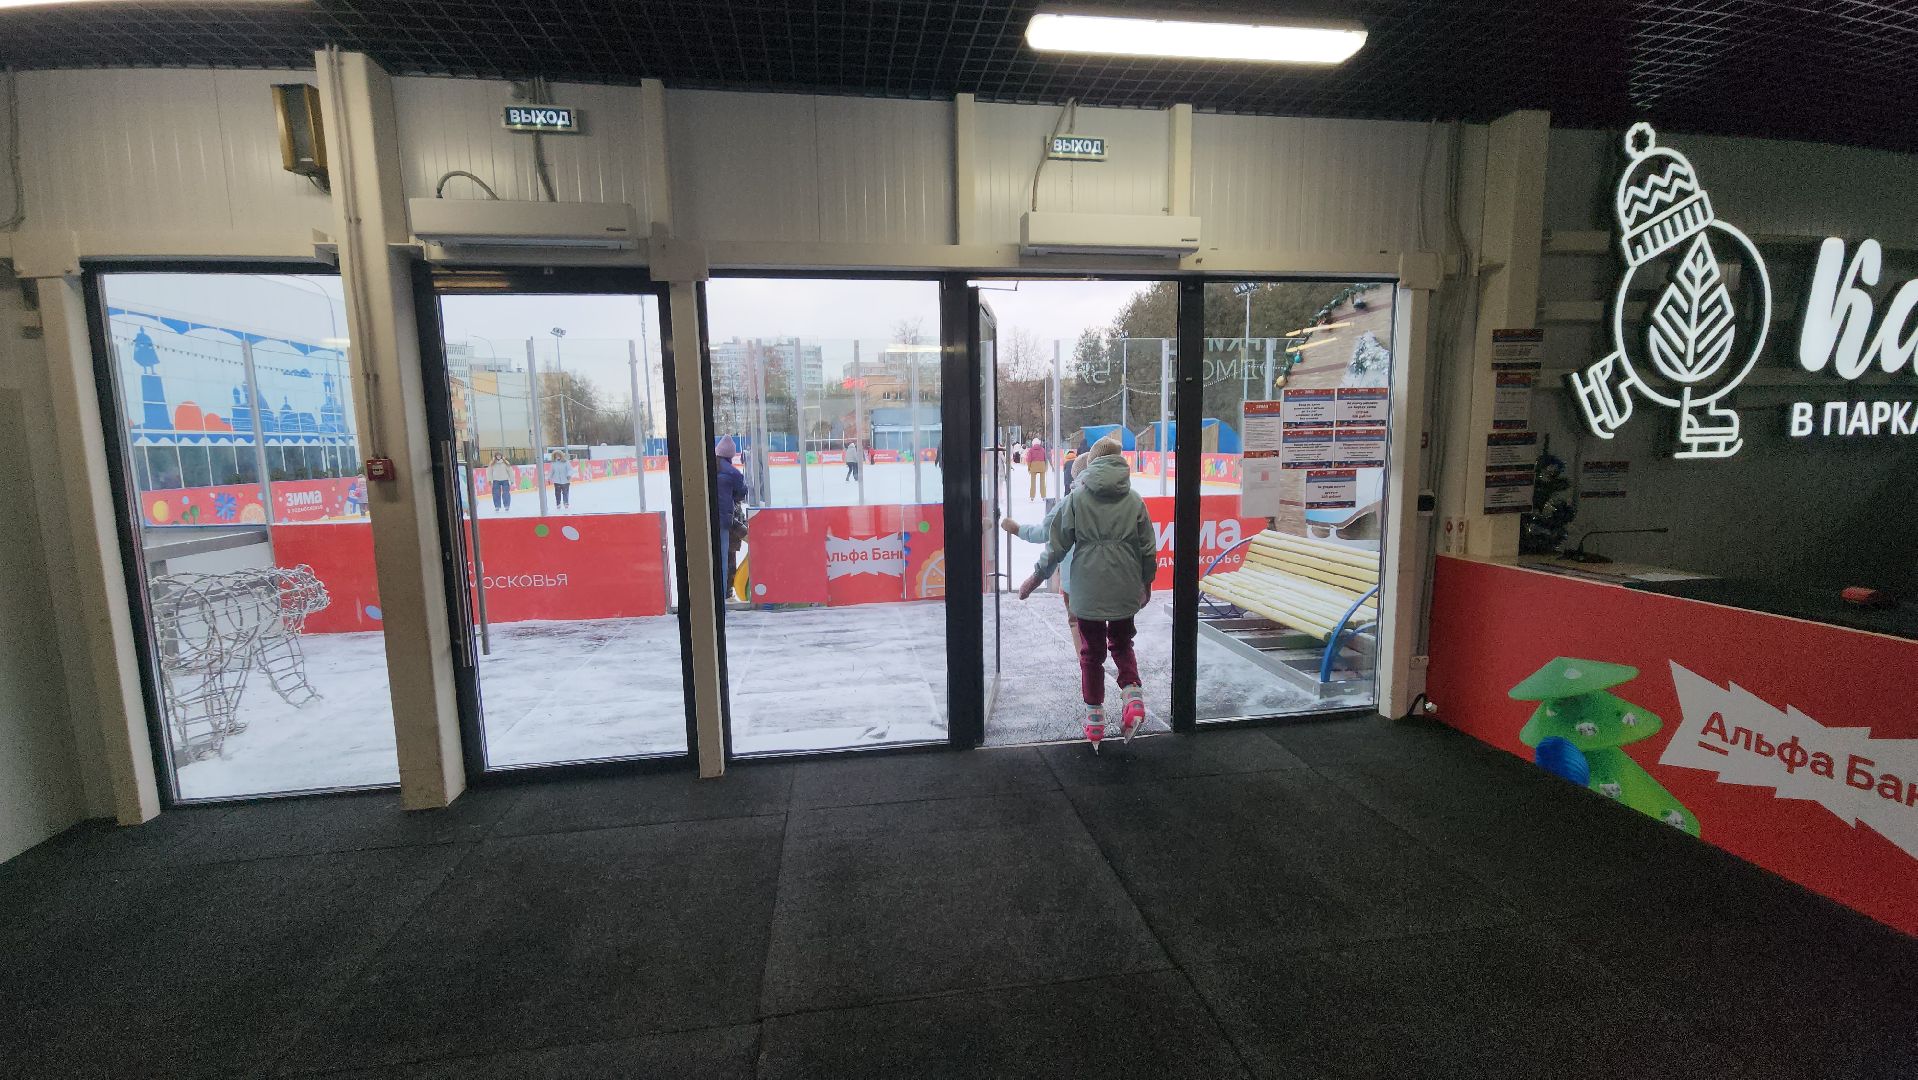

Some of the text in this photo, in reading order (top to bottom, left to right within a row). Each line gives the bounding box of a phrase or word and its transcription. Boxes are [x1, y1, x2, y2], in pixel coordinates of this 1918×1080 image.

[509, 109, 570, 126] ВЫХОД
[1053, 139, 1102, 154] ВЫХОД
[1791, 402, 1813, 436] В
[1698, 711, 1835, 780] Альфа
